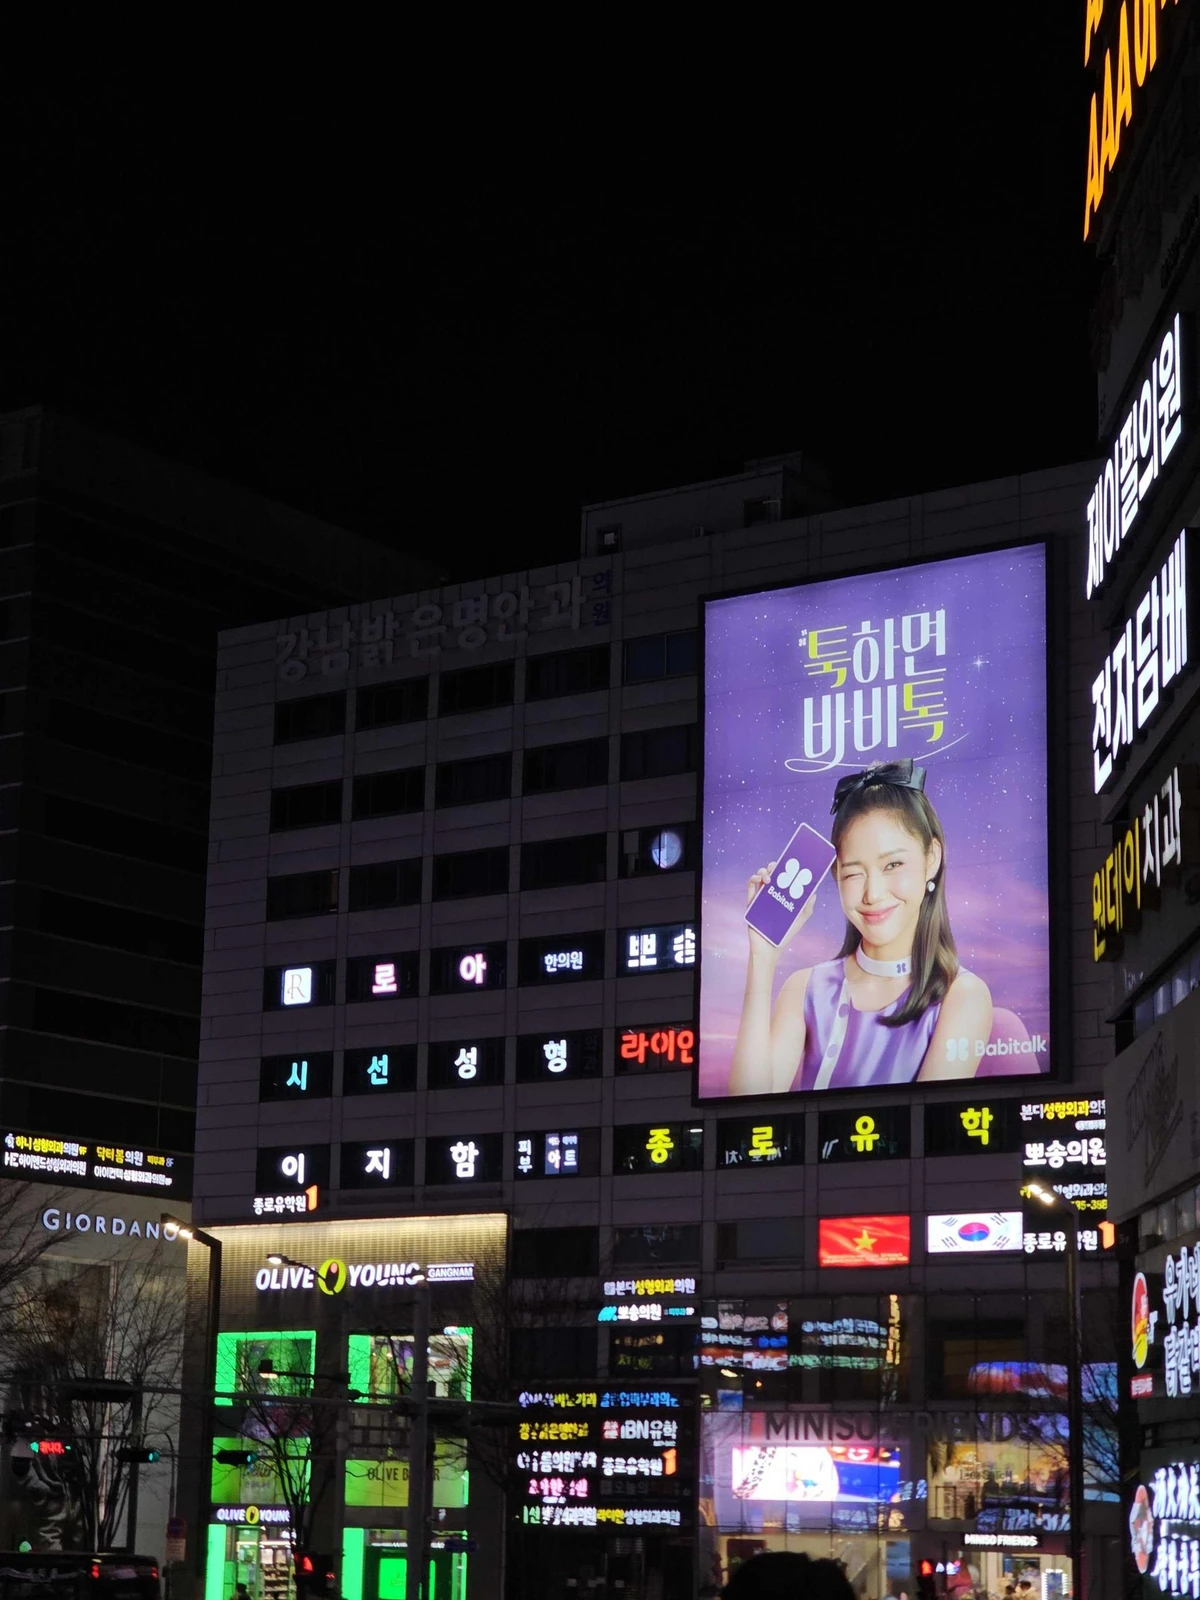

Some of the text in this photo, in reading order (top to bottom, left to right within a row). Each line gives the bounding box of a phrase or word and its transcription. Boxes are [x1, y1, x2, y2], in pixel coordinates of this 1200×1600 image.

[1086, 312, 1182, 600] 제이필의원
[277, 576, 588, 684] 강남밝은명안과
[1092, 528, 1188, 795] 전자담배
[767, 886, 795, 913] Babitalk
[546, 951, 583, 973] 한의원
[975, 1036, 1048, 1056] Babitalk
[518, 1139, 533, 1173] 피부
[253, 1196, 306, 1215] 종로유학원
[42, 1208, 178, 1242] GIORDANO
[1023, 1230, 1098, 1254] 종로유원
[255, 1262, 474, 1290] OLIVE YOUNG GANGNAM
[616, 1279, 695, 1296] 본디성형외과의원
[764, 1411, 877, 1442] MINISO
[216, 1508, 246, 1522] OLIVE
[964, 1533, 1038, 1547] MINISO FRIENDS
